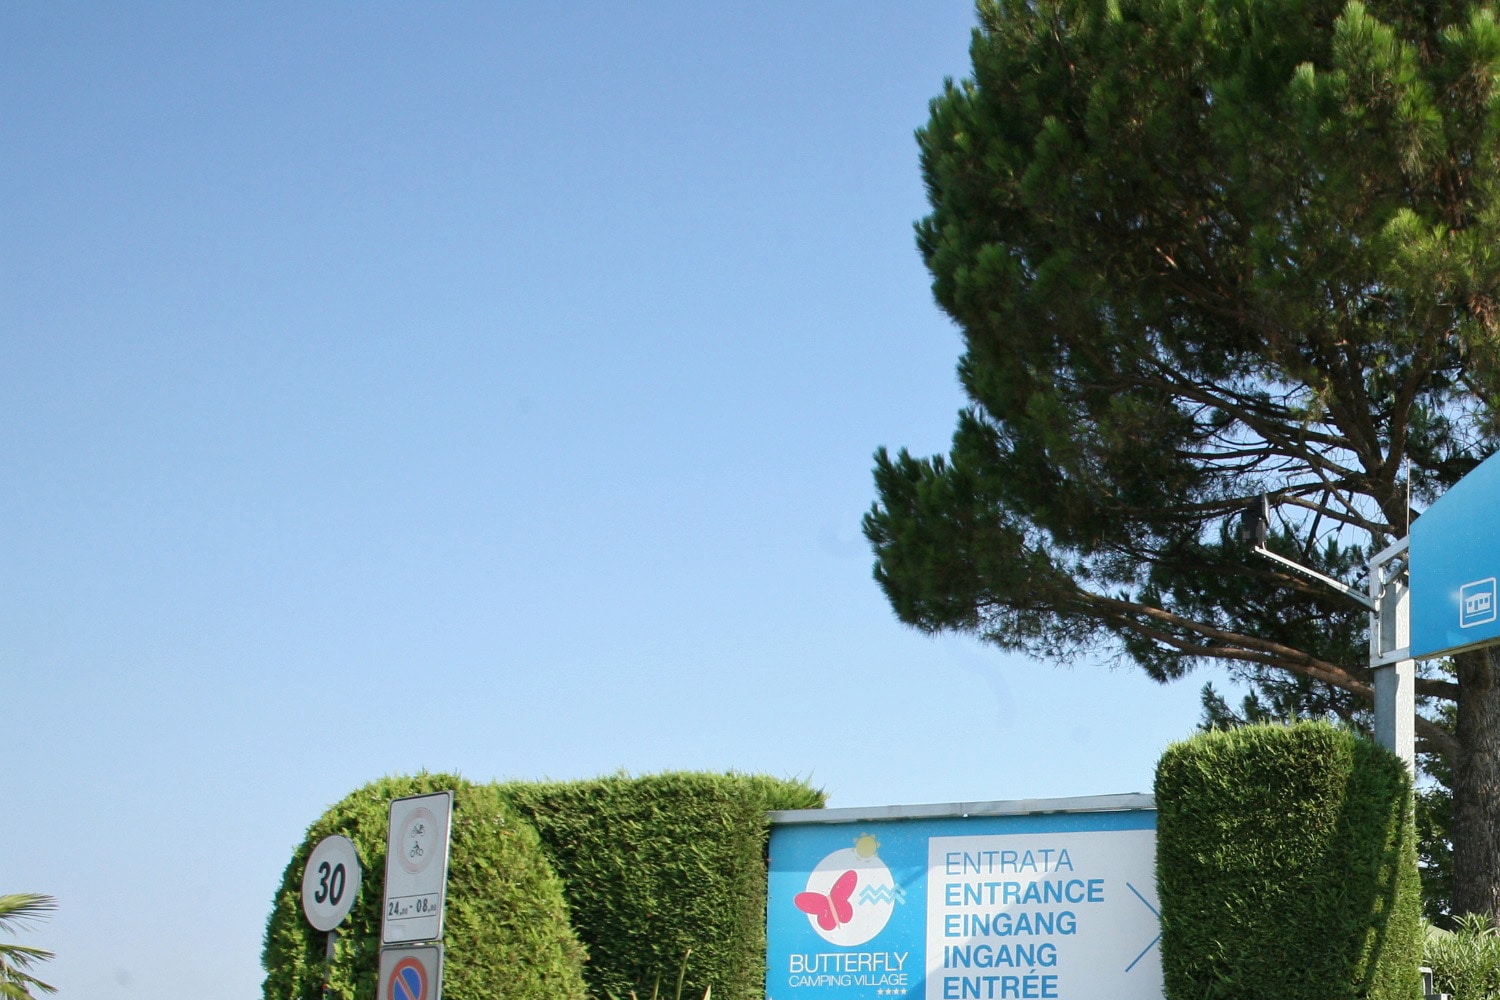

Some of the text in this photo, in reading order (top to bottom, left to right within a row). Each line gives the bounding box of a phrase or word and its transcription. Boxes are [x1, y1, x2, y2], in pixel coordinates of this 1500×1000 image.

[945, 848, 1074, 875] ENTRATA
[315, 861, 346, 907] 30
[945, 878, 1105, 906] ENTRANCE
[944, 911, 1077, 938] EINGANG
[789, 951, 909, 973] BUTTERFLY
[943, 943, 1058, 969] INGANG
[788, 973, 909, 988] CAMPING VILLAGE
[943, 969, 1059, 999] ENTRÉE
